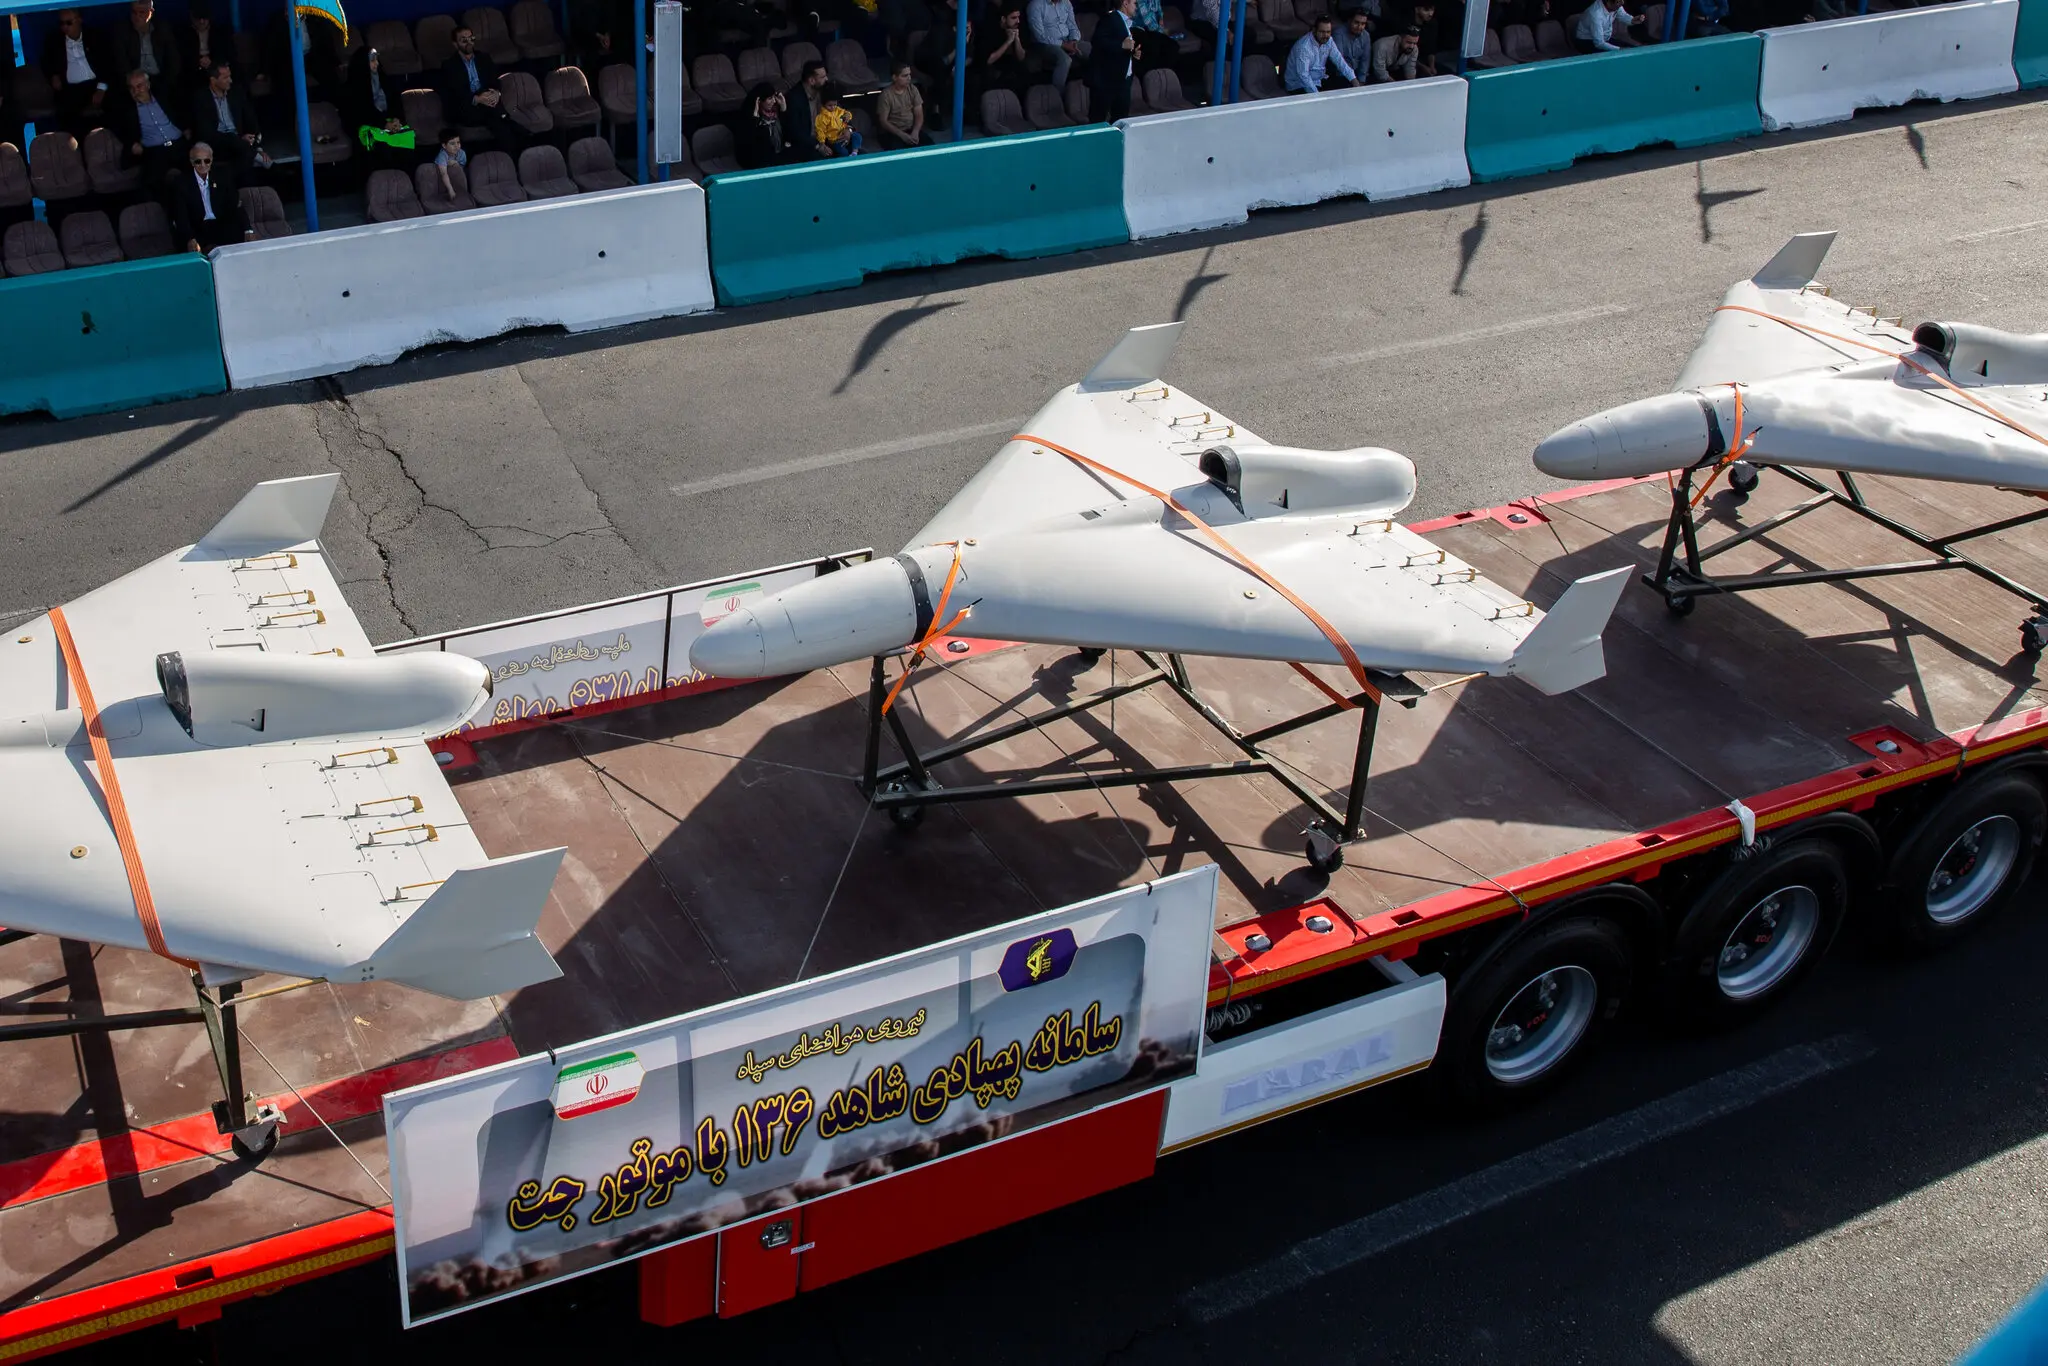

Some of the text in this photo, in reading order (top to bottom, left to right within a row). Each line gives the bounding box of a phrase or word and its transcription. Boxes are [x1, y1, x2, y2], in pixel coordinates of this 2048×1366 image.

[510, 1002, 1121, 1230] سامانه پهپادی شاهد ۱۳۶ با موتور جت
[737, 1009, 926, 1083] نیروی هوافضای سپاه
